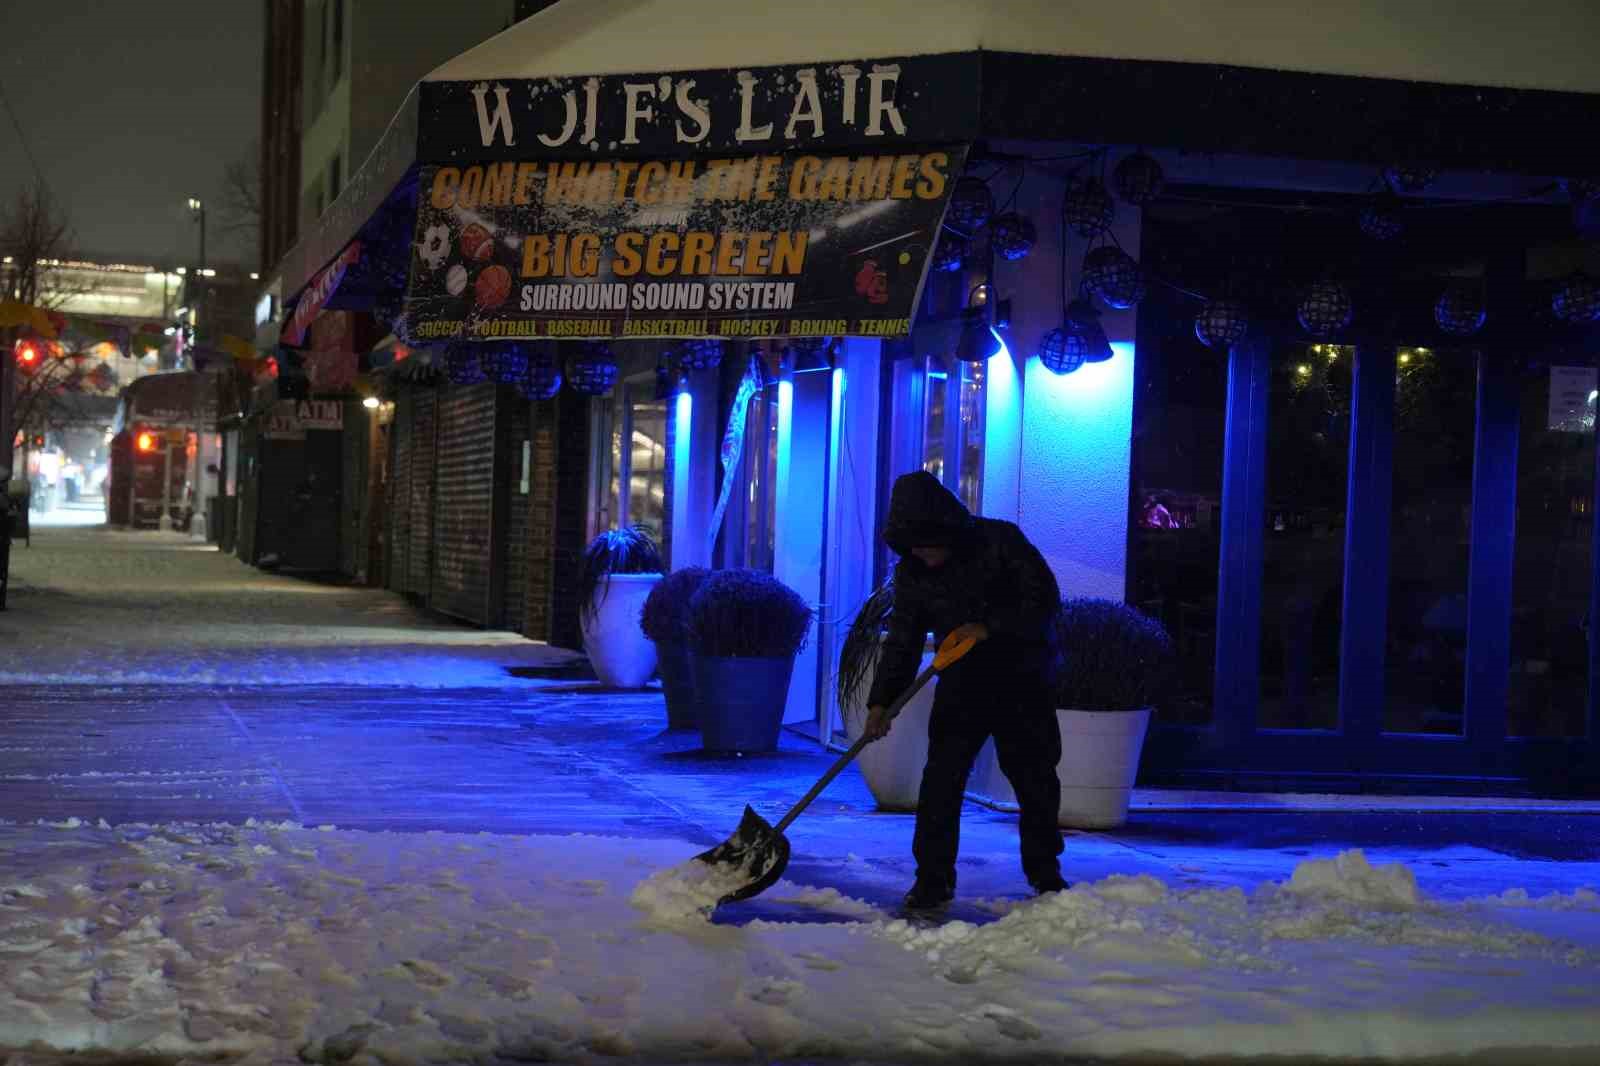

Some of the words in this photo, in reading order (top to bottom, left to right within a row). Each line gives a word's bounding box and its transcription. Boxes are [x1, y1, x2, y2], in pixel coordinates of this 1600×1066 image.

[735, 64, 907, 141] LAIR
[431, 160, 538, 208] COME
[544, 158, 696, 207] WATCH
[703, 155, 784, 202] THE
[789, 154, 948, 202] GAMES
[520, 232, 602, 279] BIG
[611, 230, 809, 278] SCREEN
[520, 282, 628, 312] SURROUND
[631, 282, 704, 311] SOUND
[707, 281, 796, 311] SYSTEM
[416, 320, 464, 338] SOCCER
[472, 319, 542, 337] FOOTBALL
[547, 319, 612, 337] BASEBALL
[622, 319, 709, 337] BASKETBALL
[719, 319, 779, 336] HOCKEY
[789, 319, 847, 336] BOXING
[858, 319, 910, 336] TENNIS
[298, 400, 338, 419] ATM
